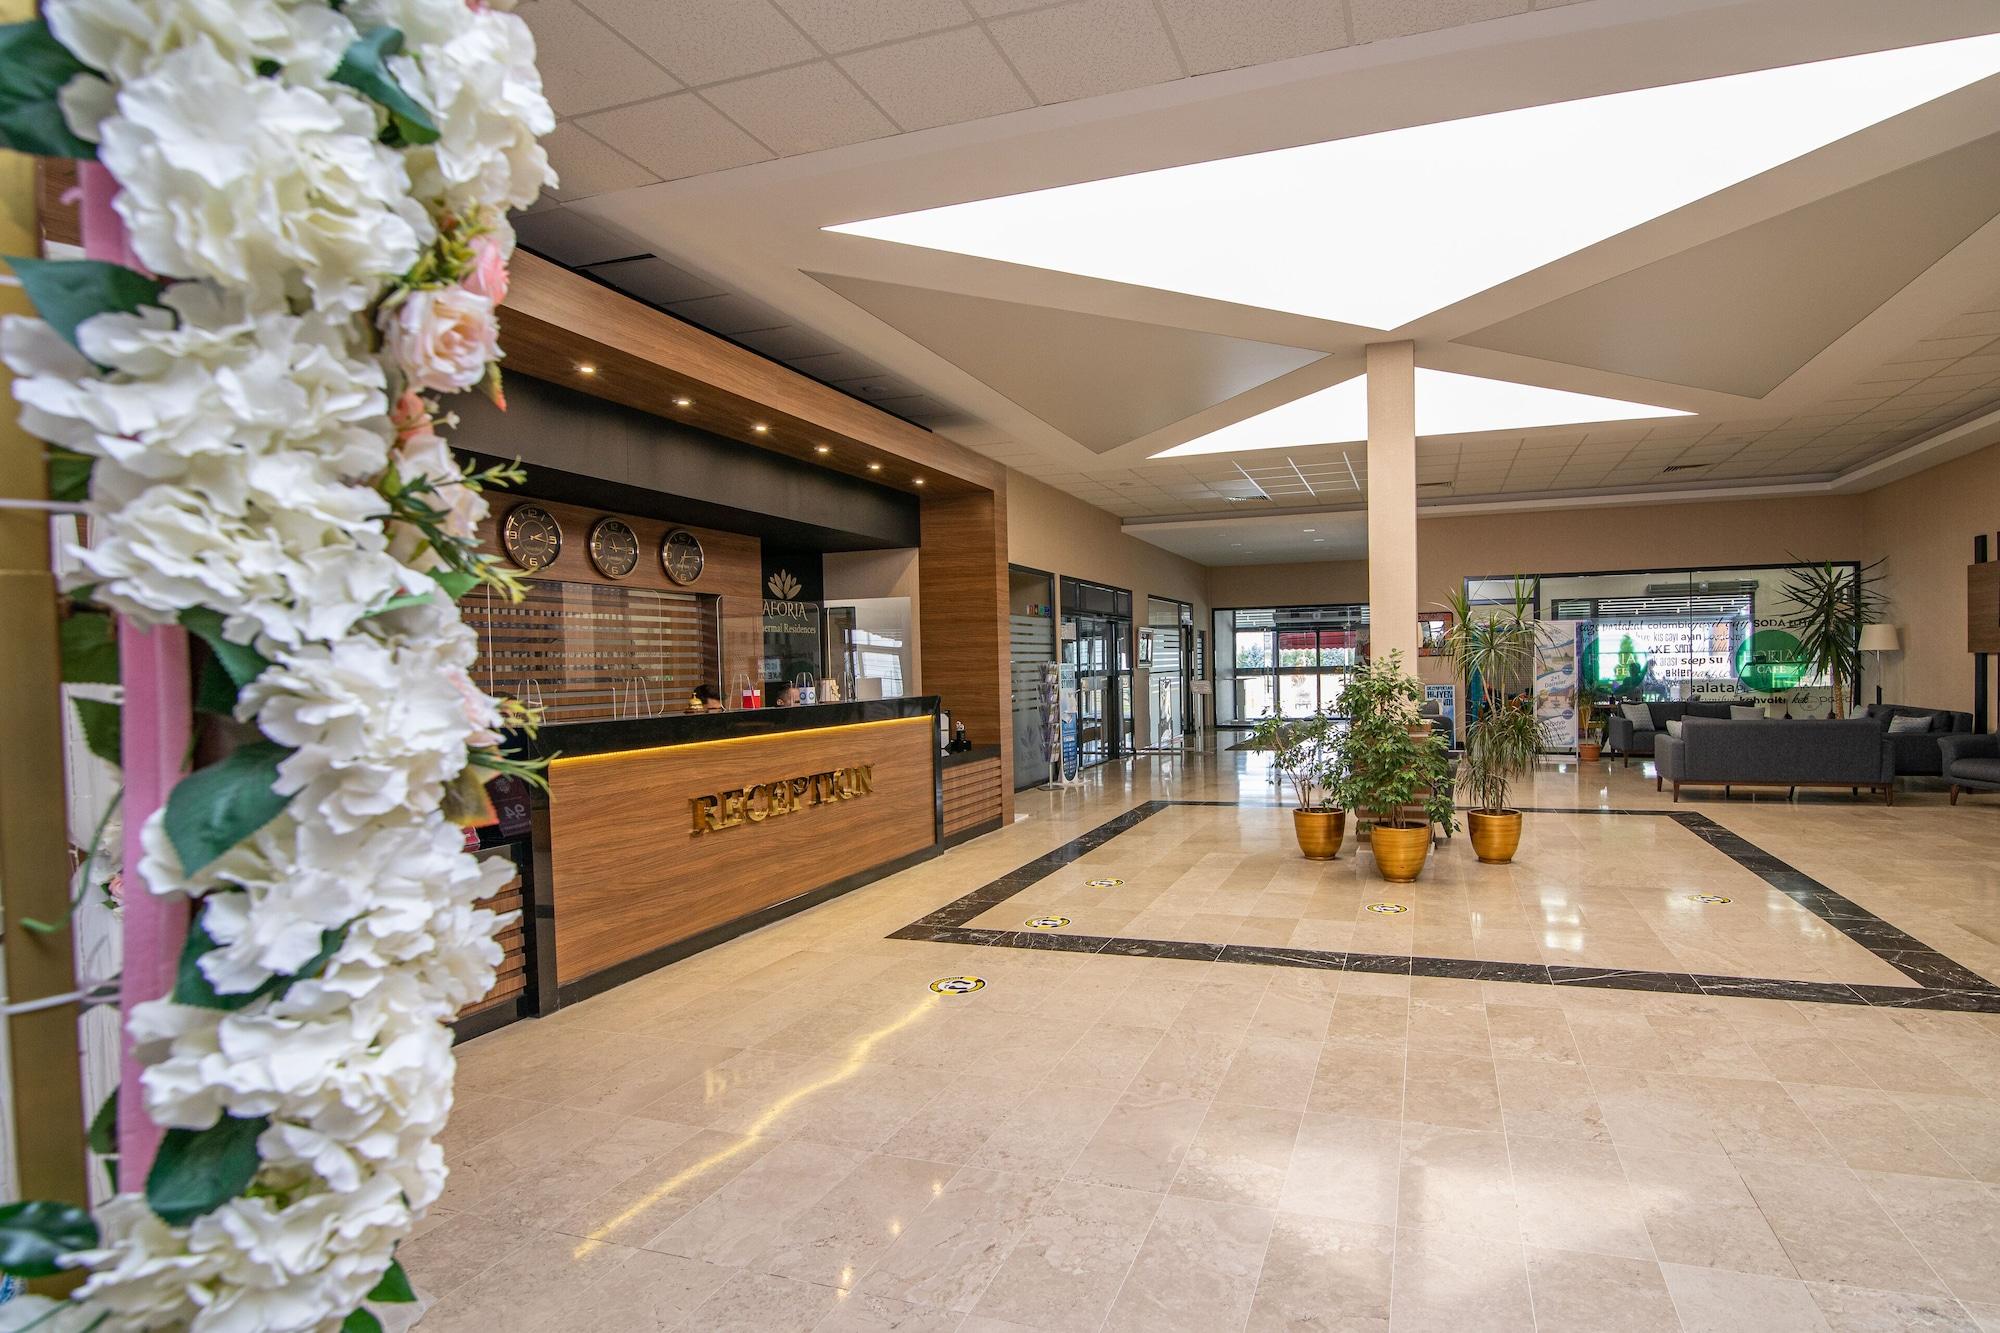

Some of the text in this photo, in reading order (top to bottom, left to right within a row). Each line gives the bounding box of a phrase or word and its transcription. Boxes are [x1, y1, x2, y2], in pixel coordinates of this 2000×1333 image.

[763, 600, 809, 622] AFORIA
[763, 623, 816, 634] ermal Residences
[1754, 619, 1786, 628] SODA
[689, 763, 875, 838] RECEPTION
